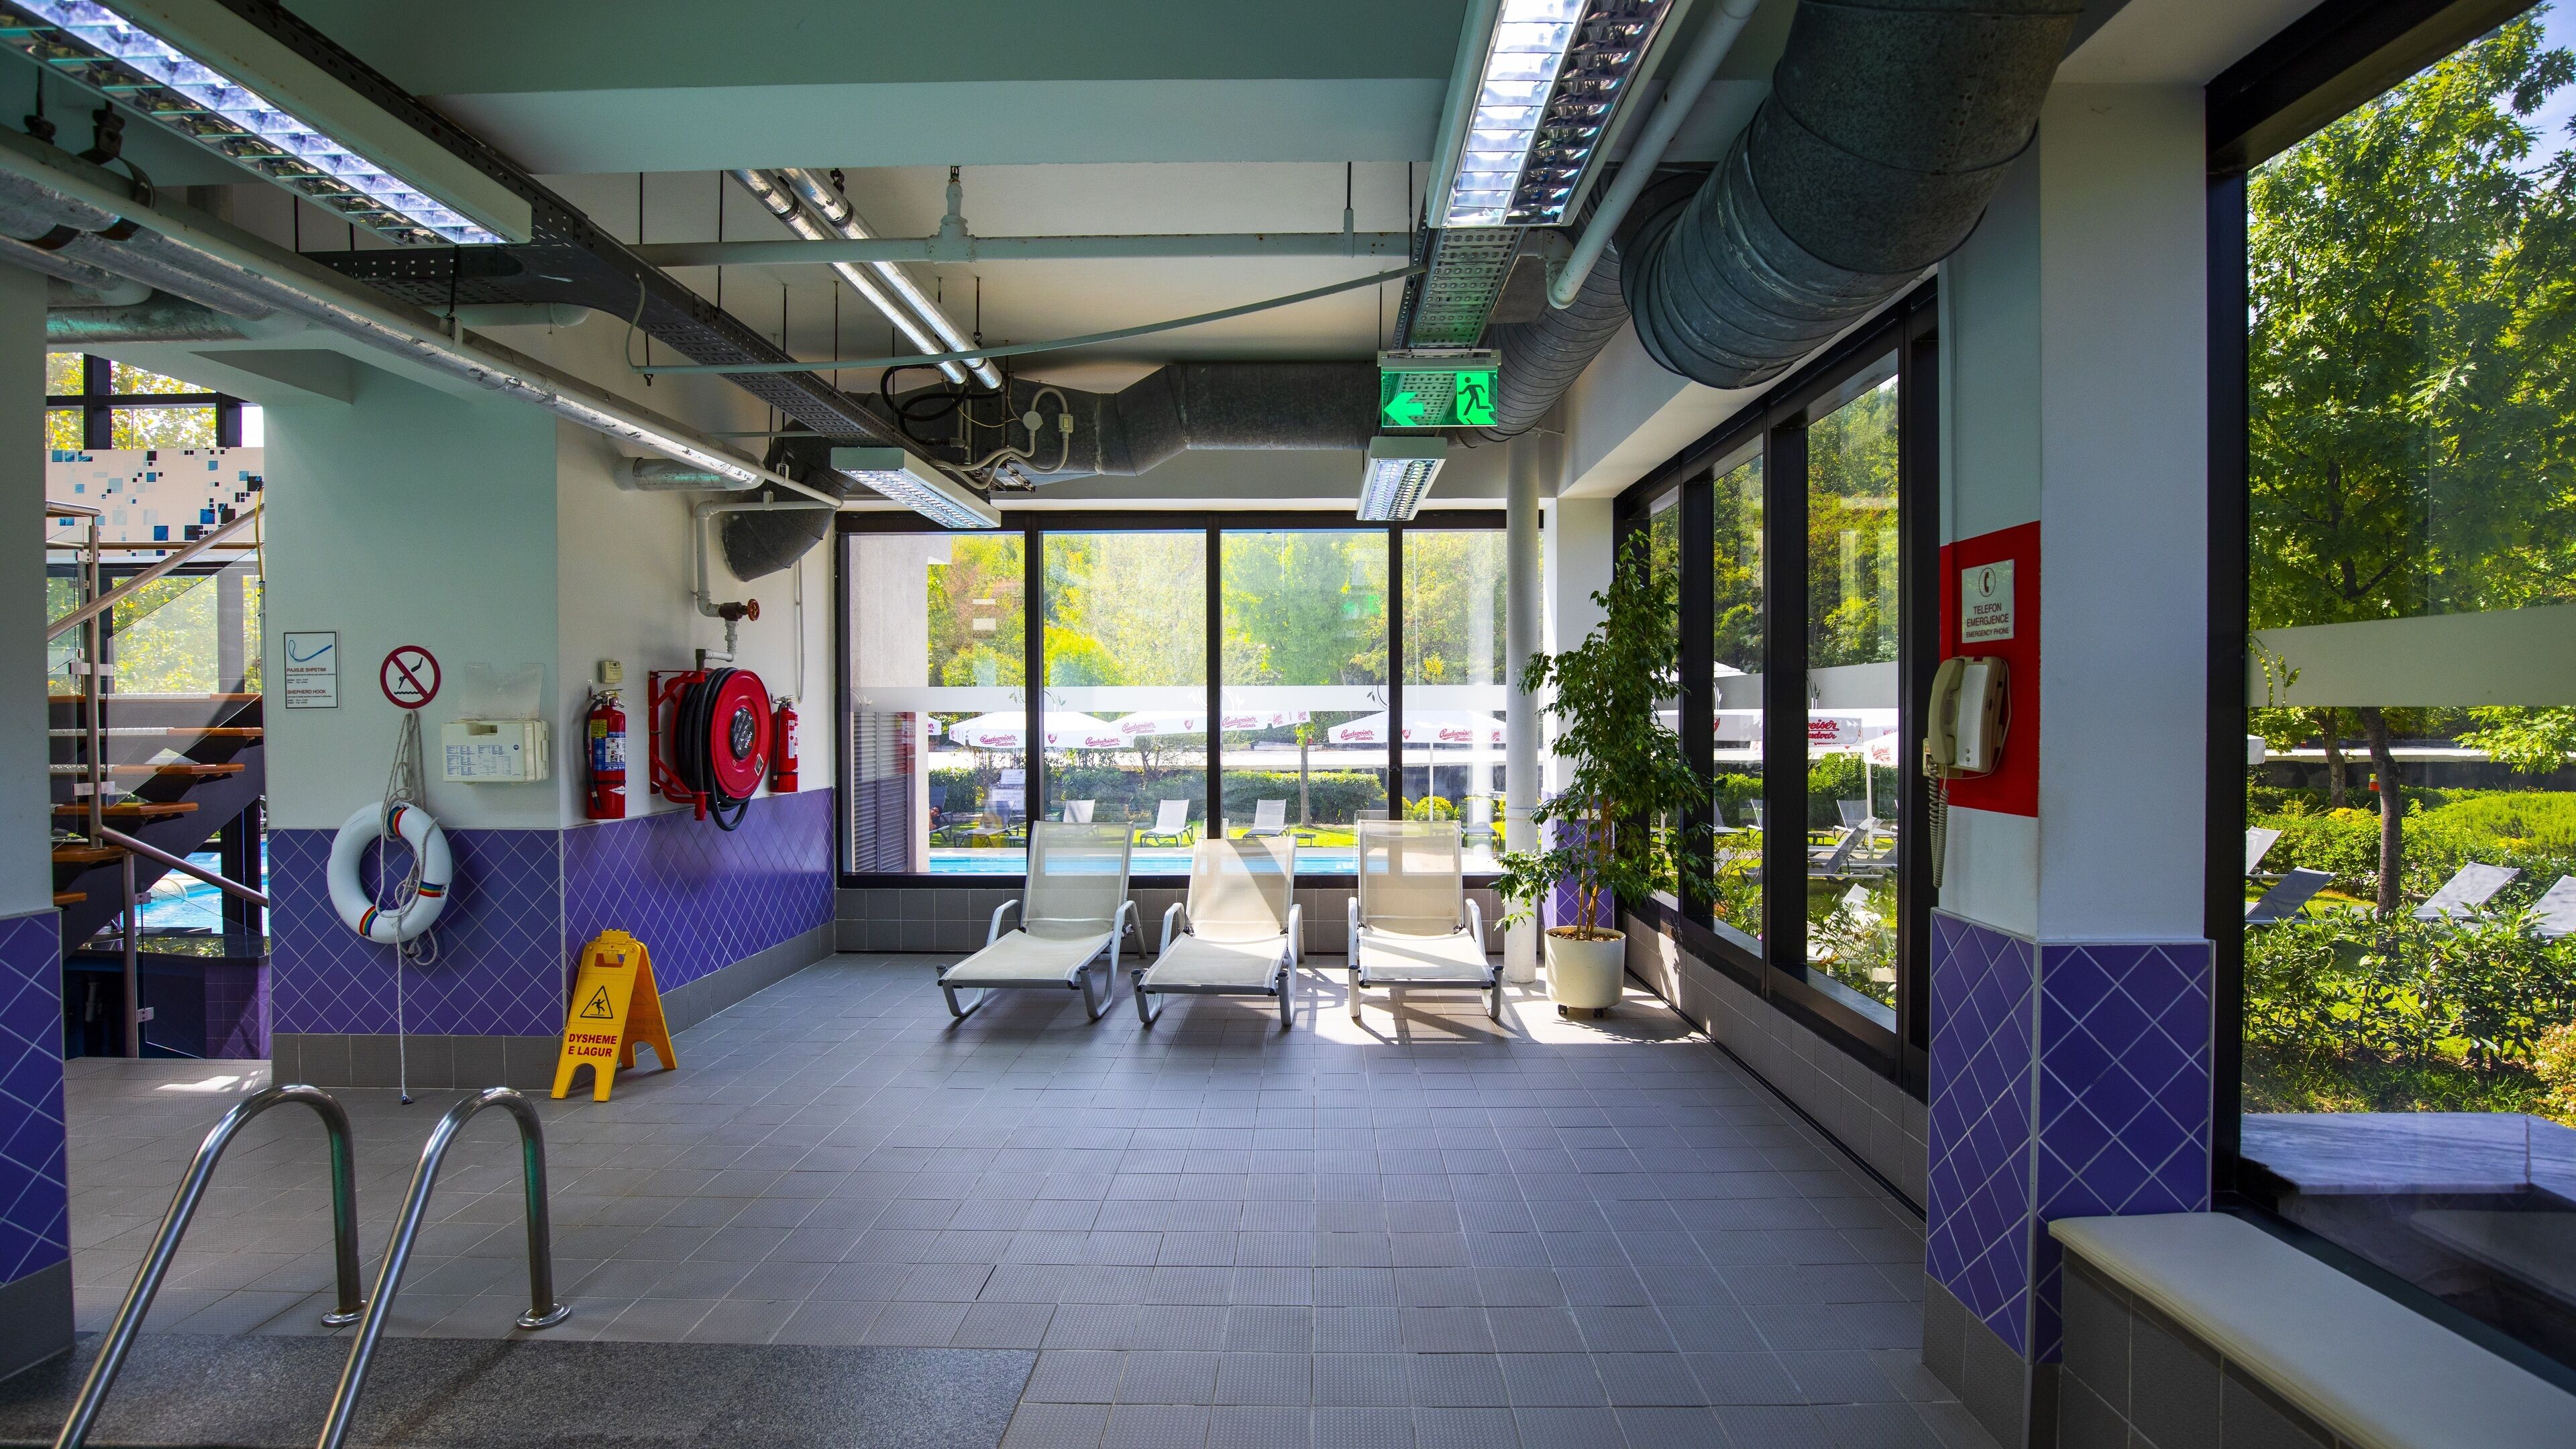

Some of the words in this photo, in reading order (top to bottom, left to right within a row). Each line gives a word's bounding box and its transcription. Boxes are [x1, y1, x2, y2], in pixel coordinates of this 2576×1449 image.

[1973, 602, 2002, 614] TELEFON
[1966, 613, 2009, 627] EMERGJENCE
[1966, 629, 1992, 638] EMERGENCY
[1122, 721, 1156, 733] Budweiser
[1222, 716, 1258, 728] Budweiser
[1808, 719, 1840, 731] eiser
[979, 735, 1018, 744] Budweiser
[1340, 729, 1375, 741] Budweiser
[1808, 731, 1837, 739] udvar
[1085, 737, 1120, 747] Budweiser
[568, 1033, 618, 1044] DYSHEME
[568, 1046, 575, 1055] E
[577, 1046, 612, 1057] LAGUR
